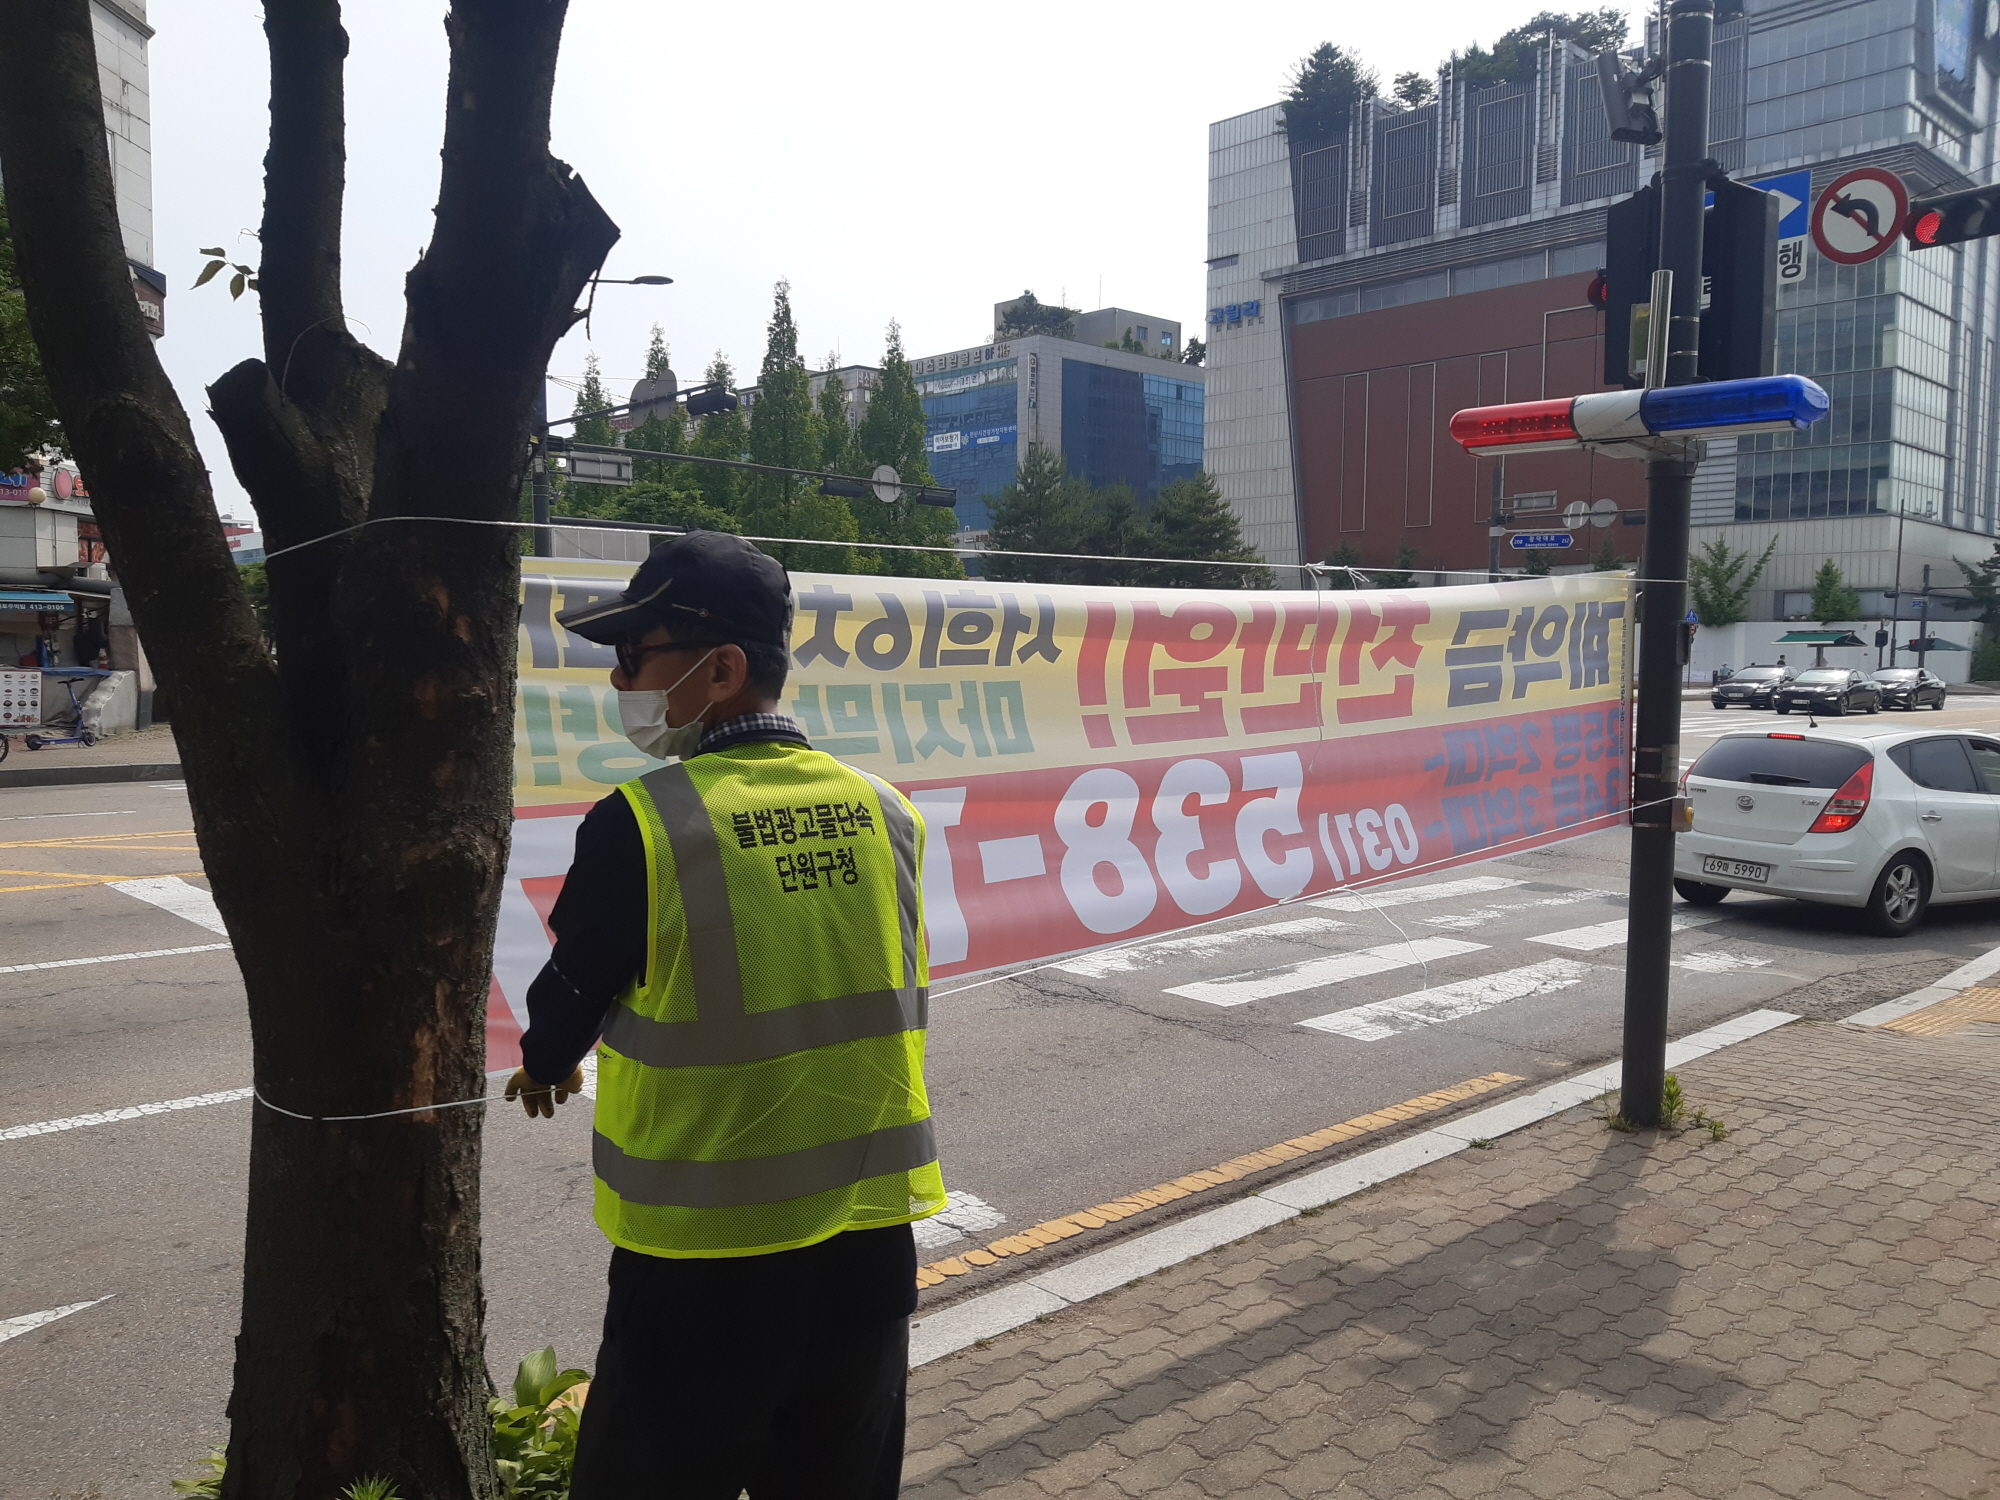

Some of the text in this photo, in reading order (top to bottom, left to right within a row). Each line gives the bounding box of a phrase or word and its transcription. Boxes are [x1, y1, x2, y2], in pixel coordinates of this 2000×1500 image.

[1778, 239, 1803, 279] 행
[1208, 299, 1260, 324] 고릴라
[731, 801, 876, 850] 불법광고물단속
[775, 846, 859, 893] 단원구청
[1733, 864, 1762, 879] 5990
